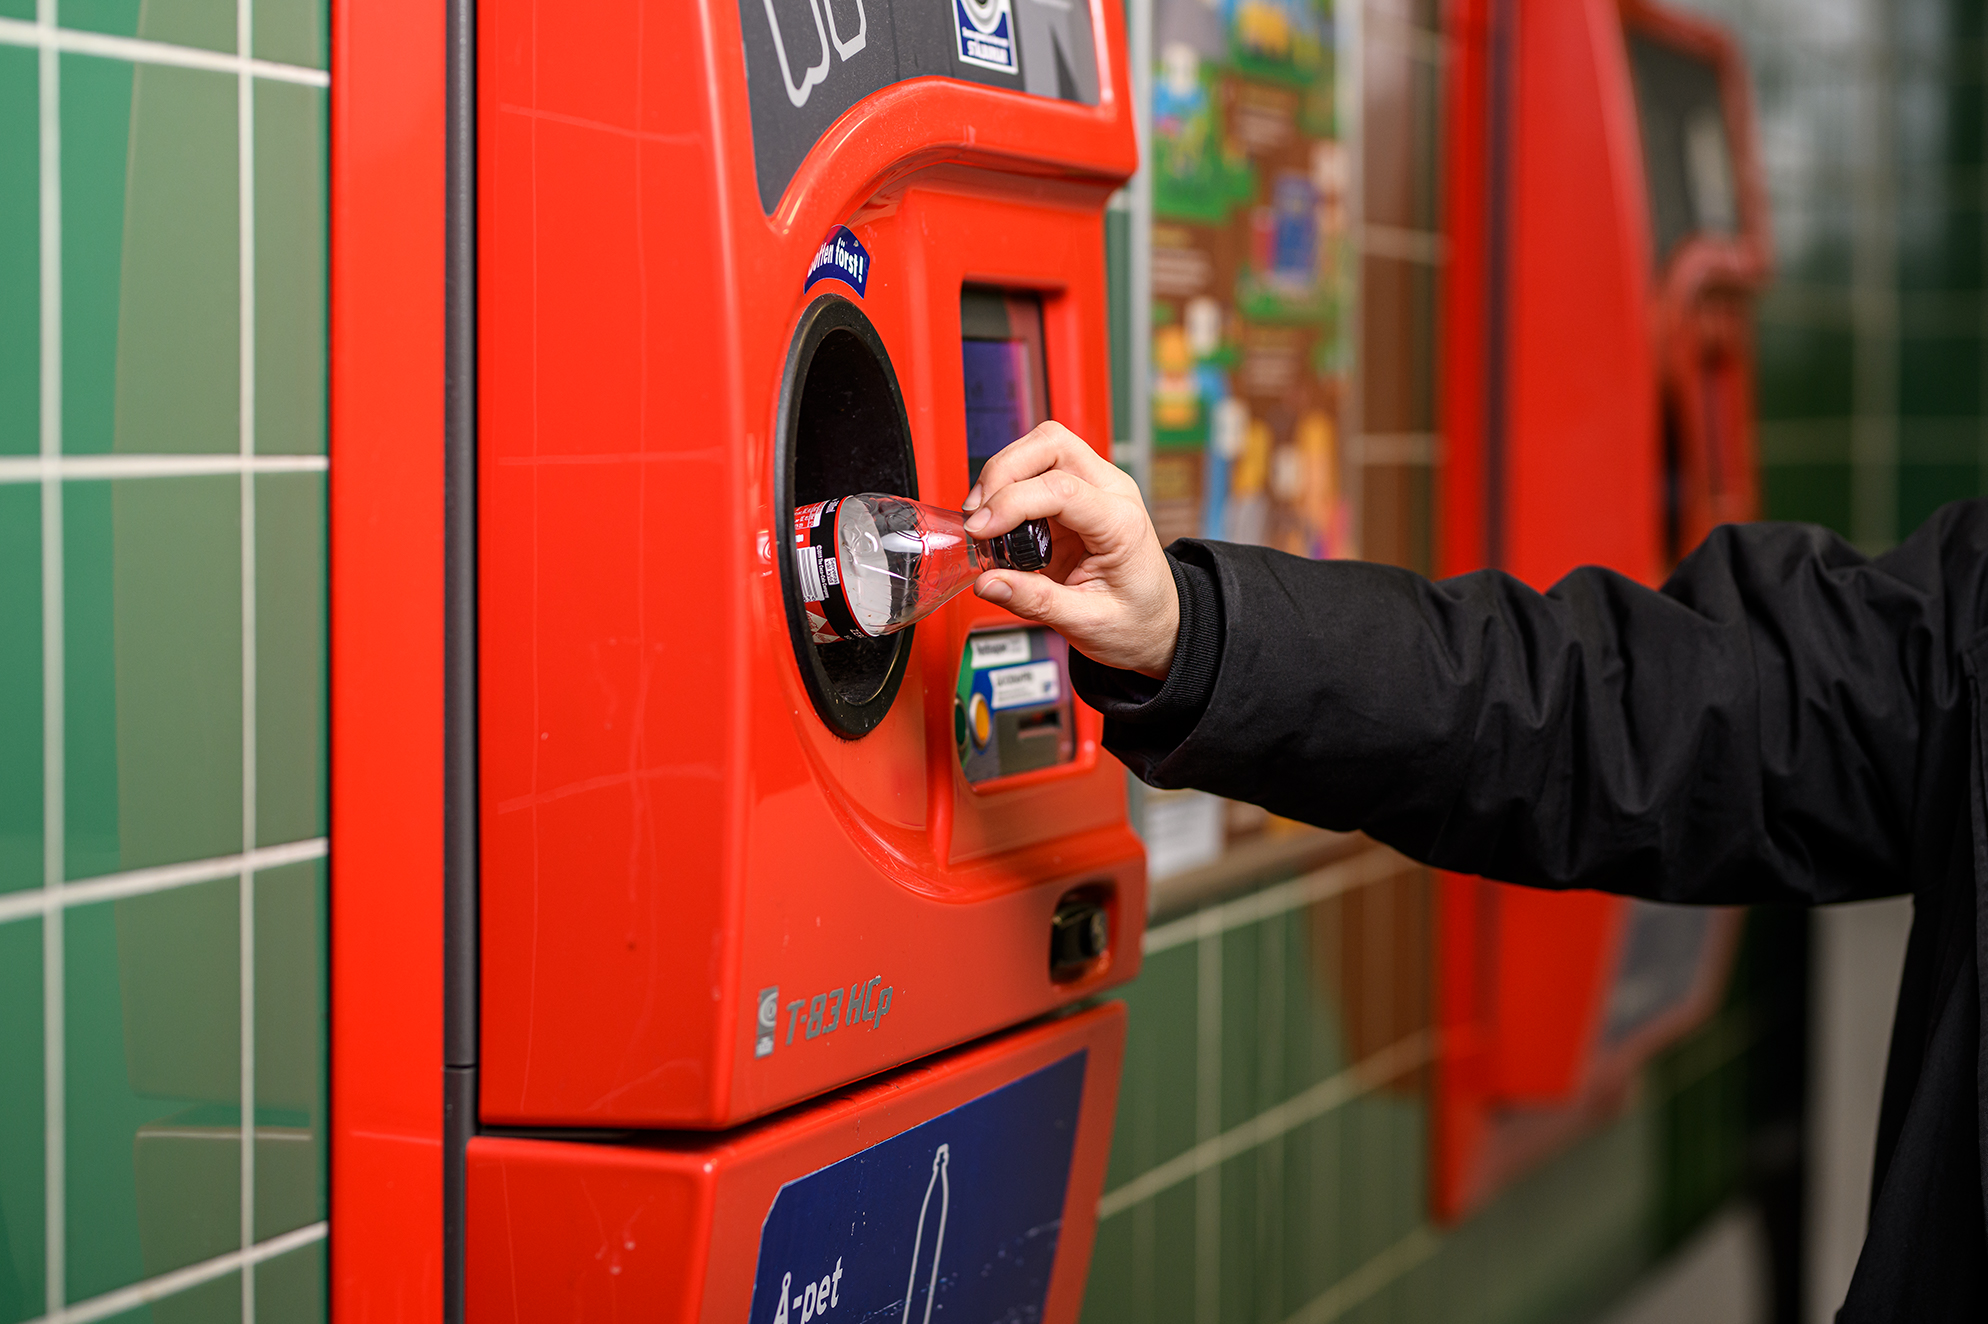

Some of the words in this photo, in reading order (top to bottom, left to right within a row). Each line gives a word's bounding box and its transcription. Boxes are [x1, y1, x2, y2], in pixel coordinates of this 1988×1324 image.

[834, 236, 864, 284] först!
[845, 975, 893, 1029] HCp
[774, 1256, 843, 1324] Å-pet
